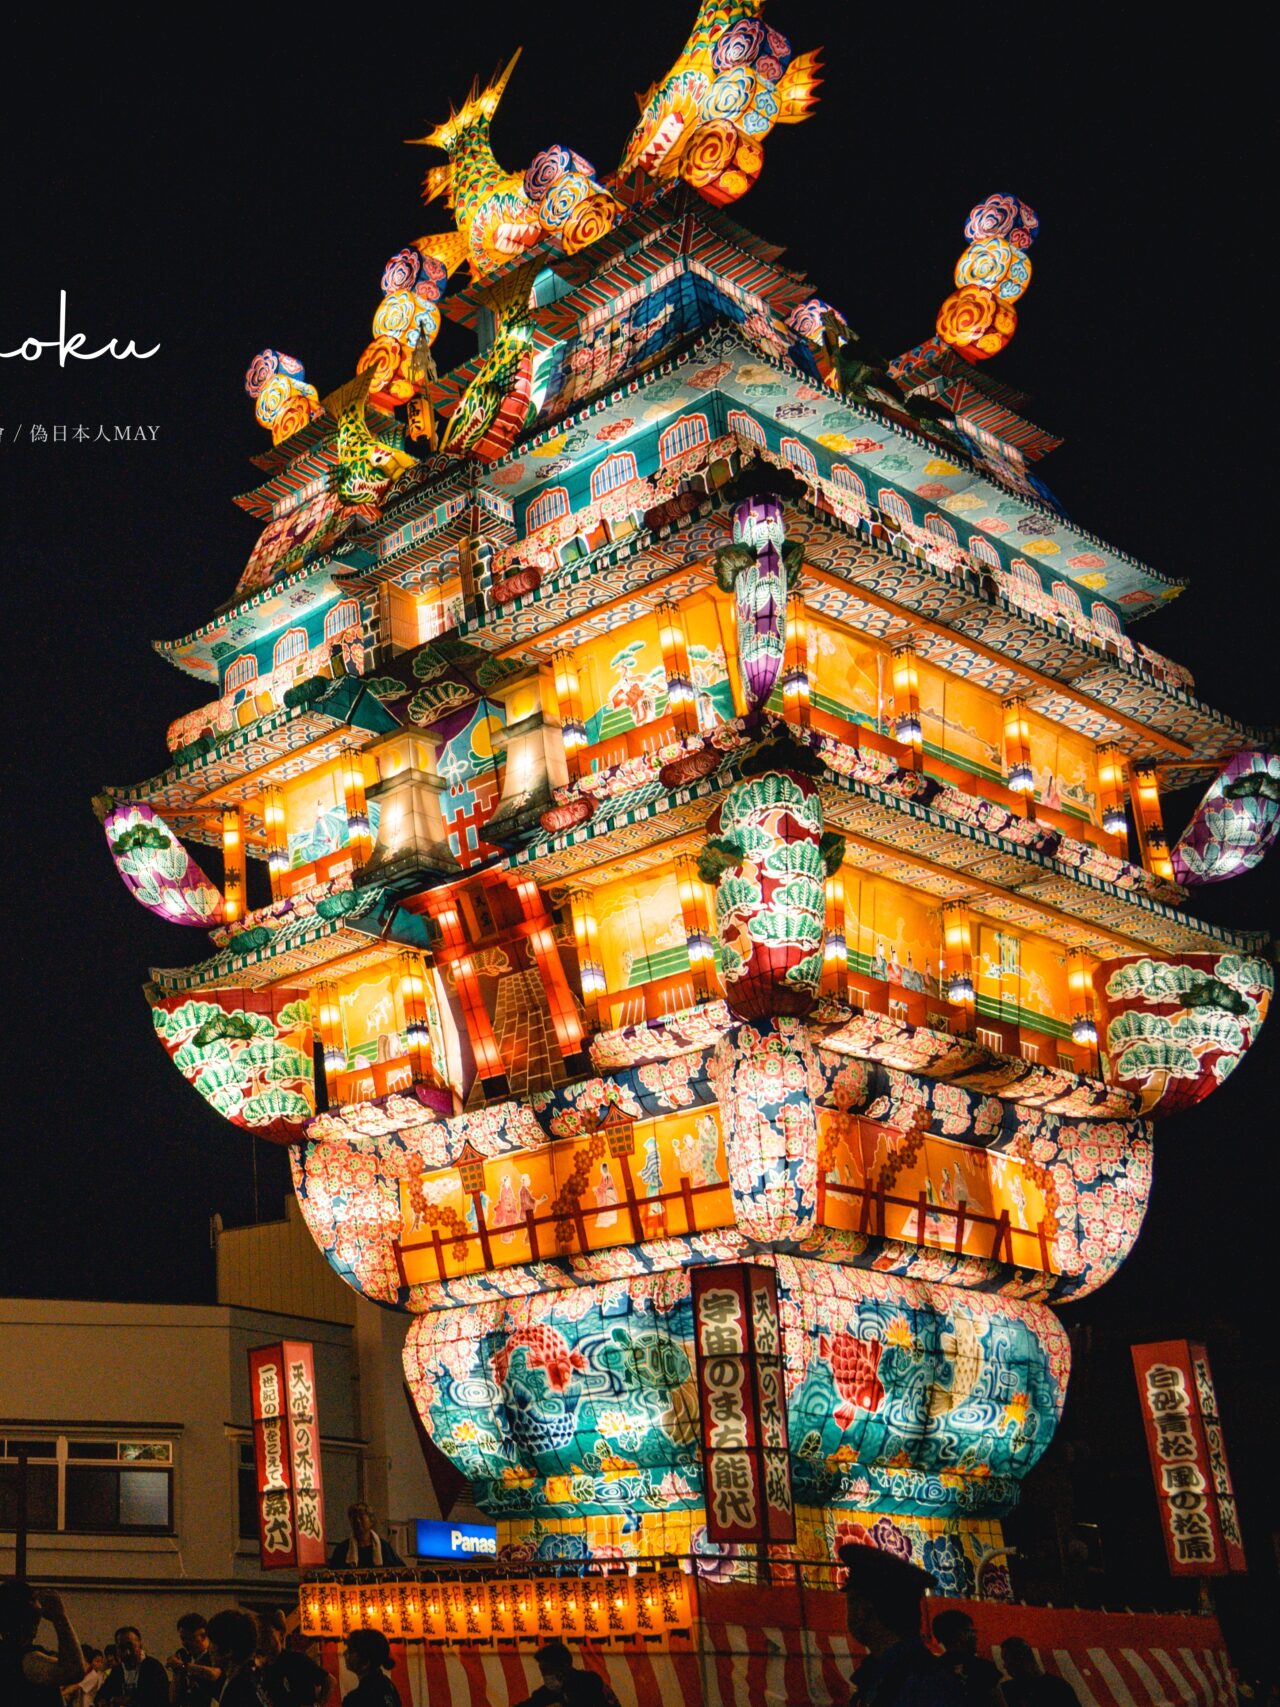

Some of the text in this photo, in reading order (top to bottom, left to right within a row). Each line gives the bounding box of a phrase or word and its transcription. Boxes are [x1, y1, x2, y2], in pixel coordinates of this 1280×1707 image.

[291, 1363, 321, 1538] 天空の不夜城
[702, 1293, 752, 1525] 宇宙のまち能代
[451, 1530, 497, 1554] Panas
